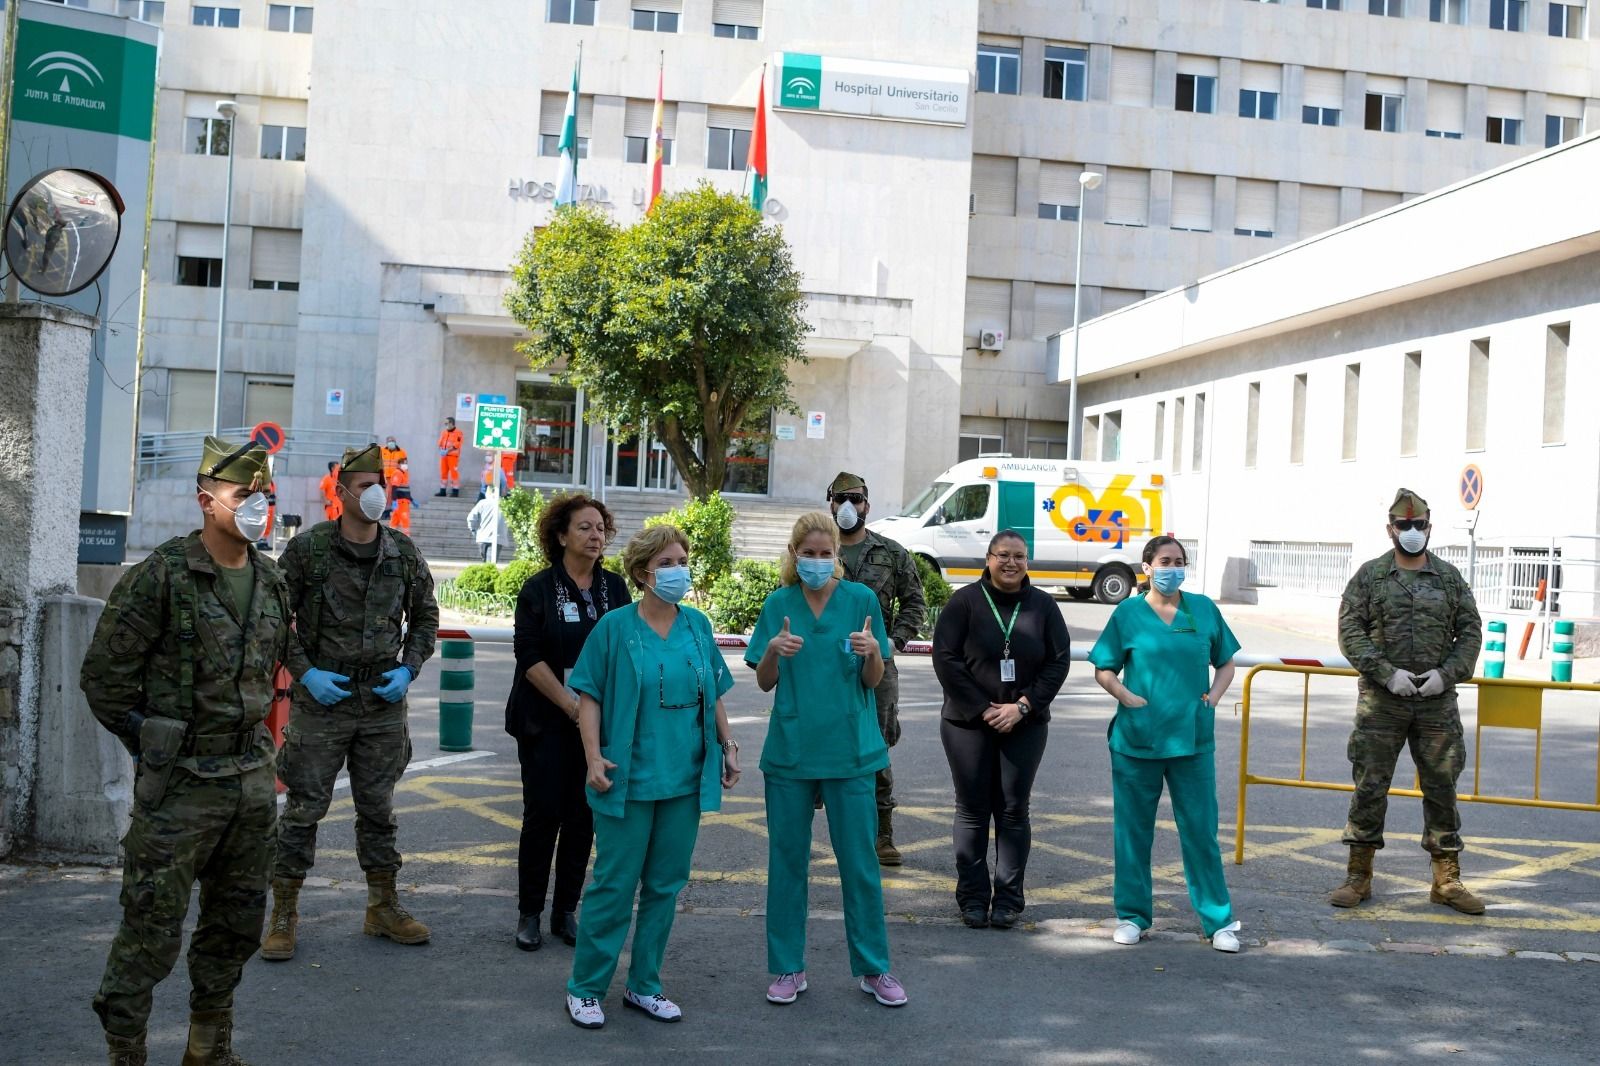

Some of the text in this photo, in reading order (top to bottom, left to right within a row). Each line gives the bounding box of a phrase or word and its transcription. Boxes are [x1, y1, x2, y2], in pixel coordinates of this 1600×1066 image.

[24, 88, 49, 100] JUNTA
[52, 93, 62, 103] DE
[835, 81, 882, 97] Hospital
[887, 86, 959, 103] Universitario
[915, 102, 930, 111] San
[508, 178, 611, 203] HOSTAL
[1001, 463, 1057, 472] AMBULANCIA
[1049, 474, 1163, 537] 061
[96, 537, 116, 545] SALUD
